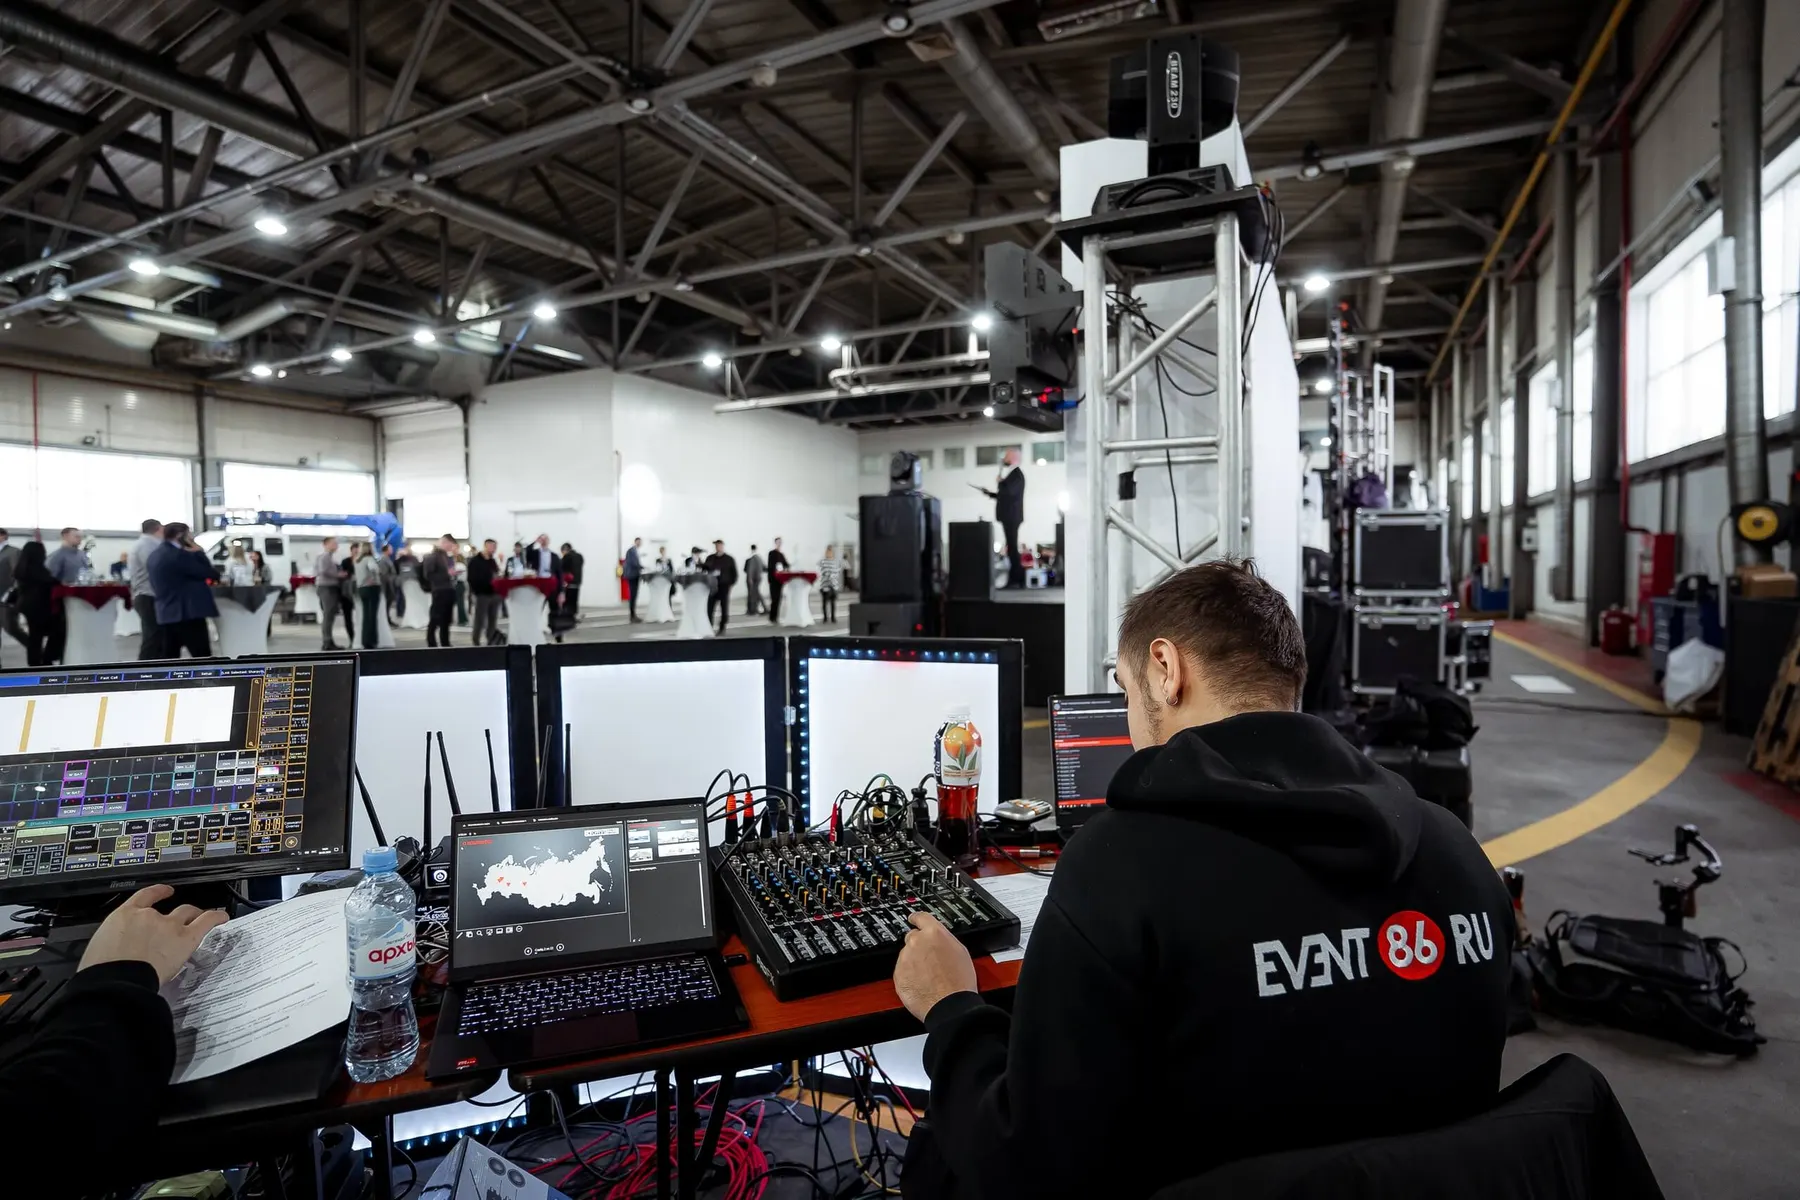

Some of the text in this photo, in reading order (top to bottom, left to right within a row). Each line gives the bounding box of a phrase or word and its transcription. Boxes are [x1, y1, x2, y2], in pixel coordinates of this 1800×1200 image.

[1170, 60, 1179, 109] BEAM 230
[1253, 912, 1493, 997] EVENT 86 RU
